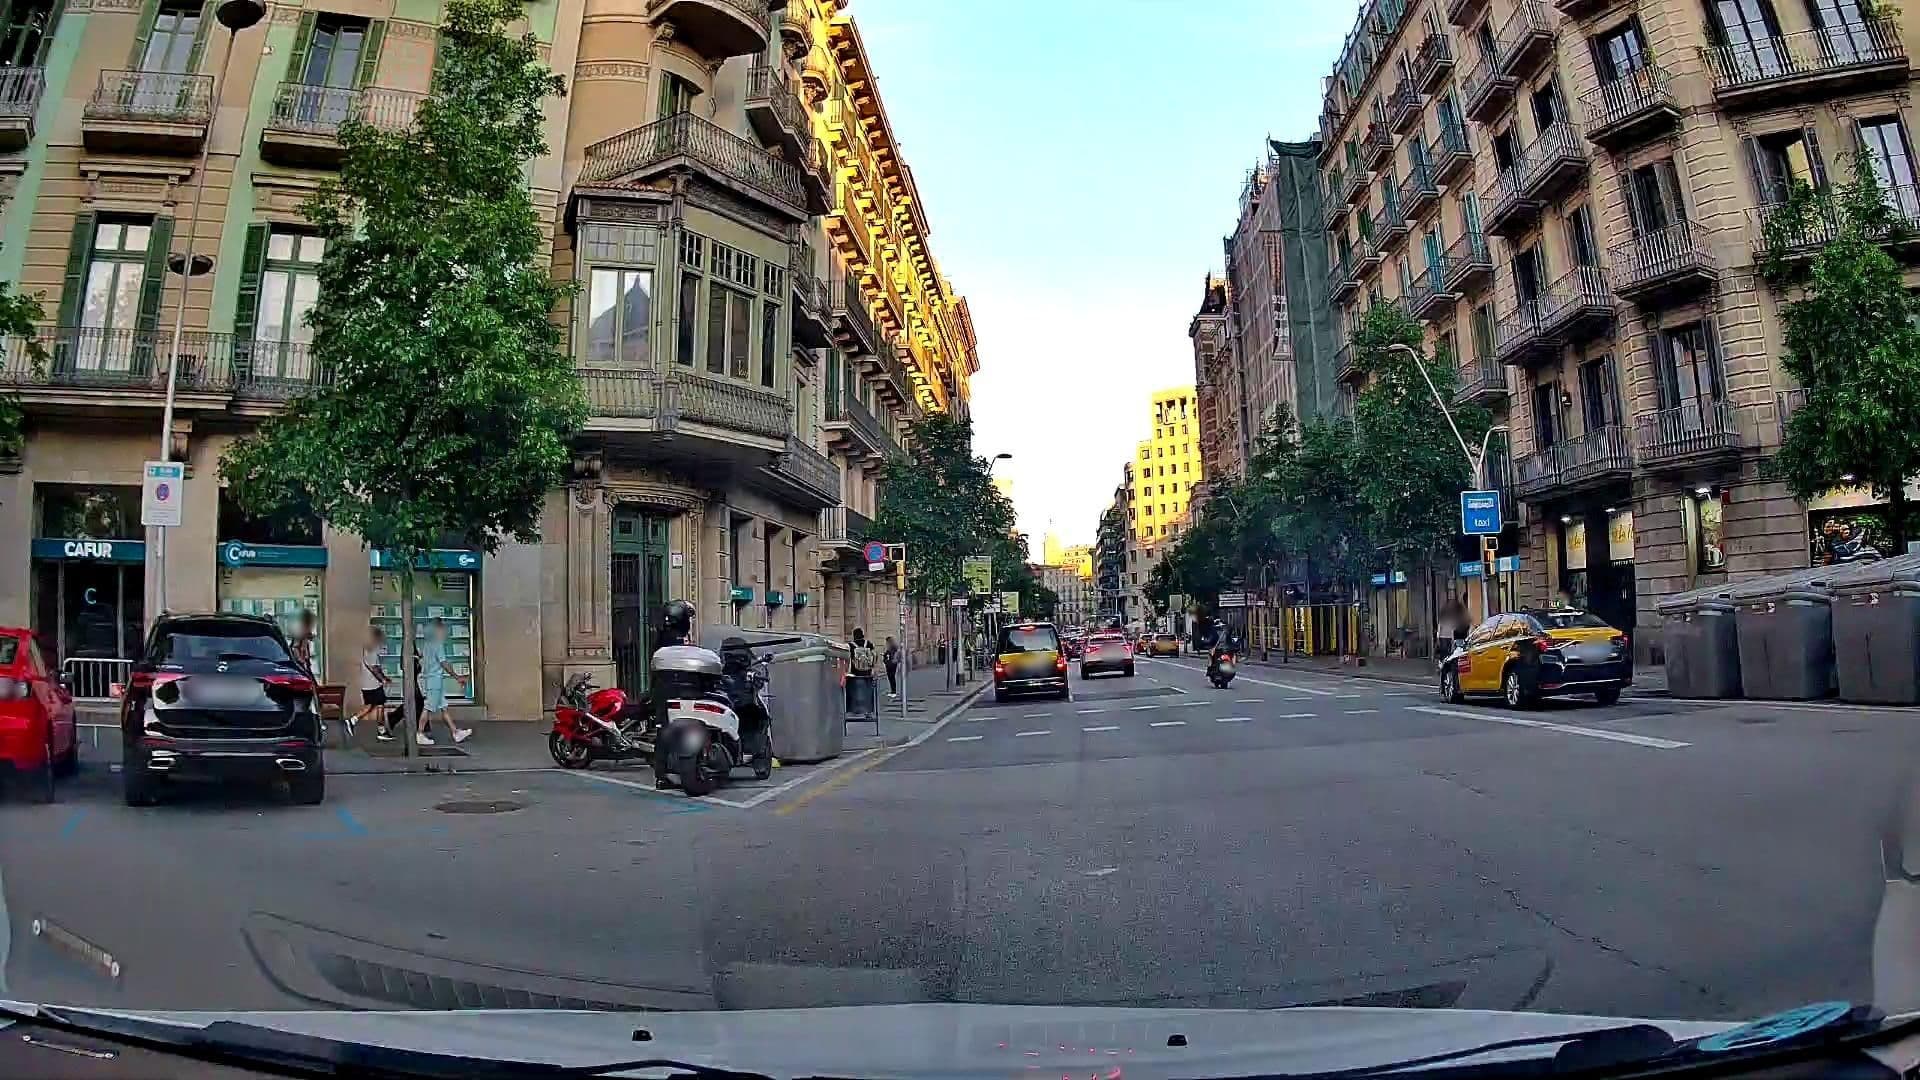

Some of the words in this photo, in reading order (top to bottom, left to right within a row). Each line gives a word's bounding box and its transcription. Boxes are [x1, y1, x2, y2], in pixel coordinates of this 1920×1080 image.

[1474, 517, 1490, 527] taxi
[64, 541, 112, 558] CAFUR
[303, 575, 319, 587] 24
[84, 587, 97, 605] C
